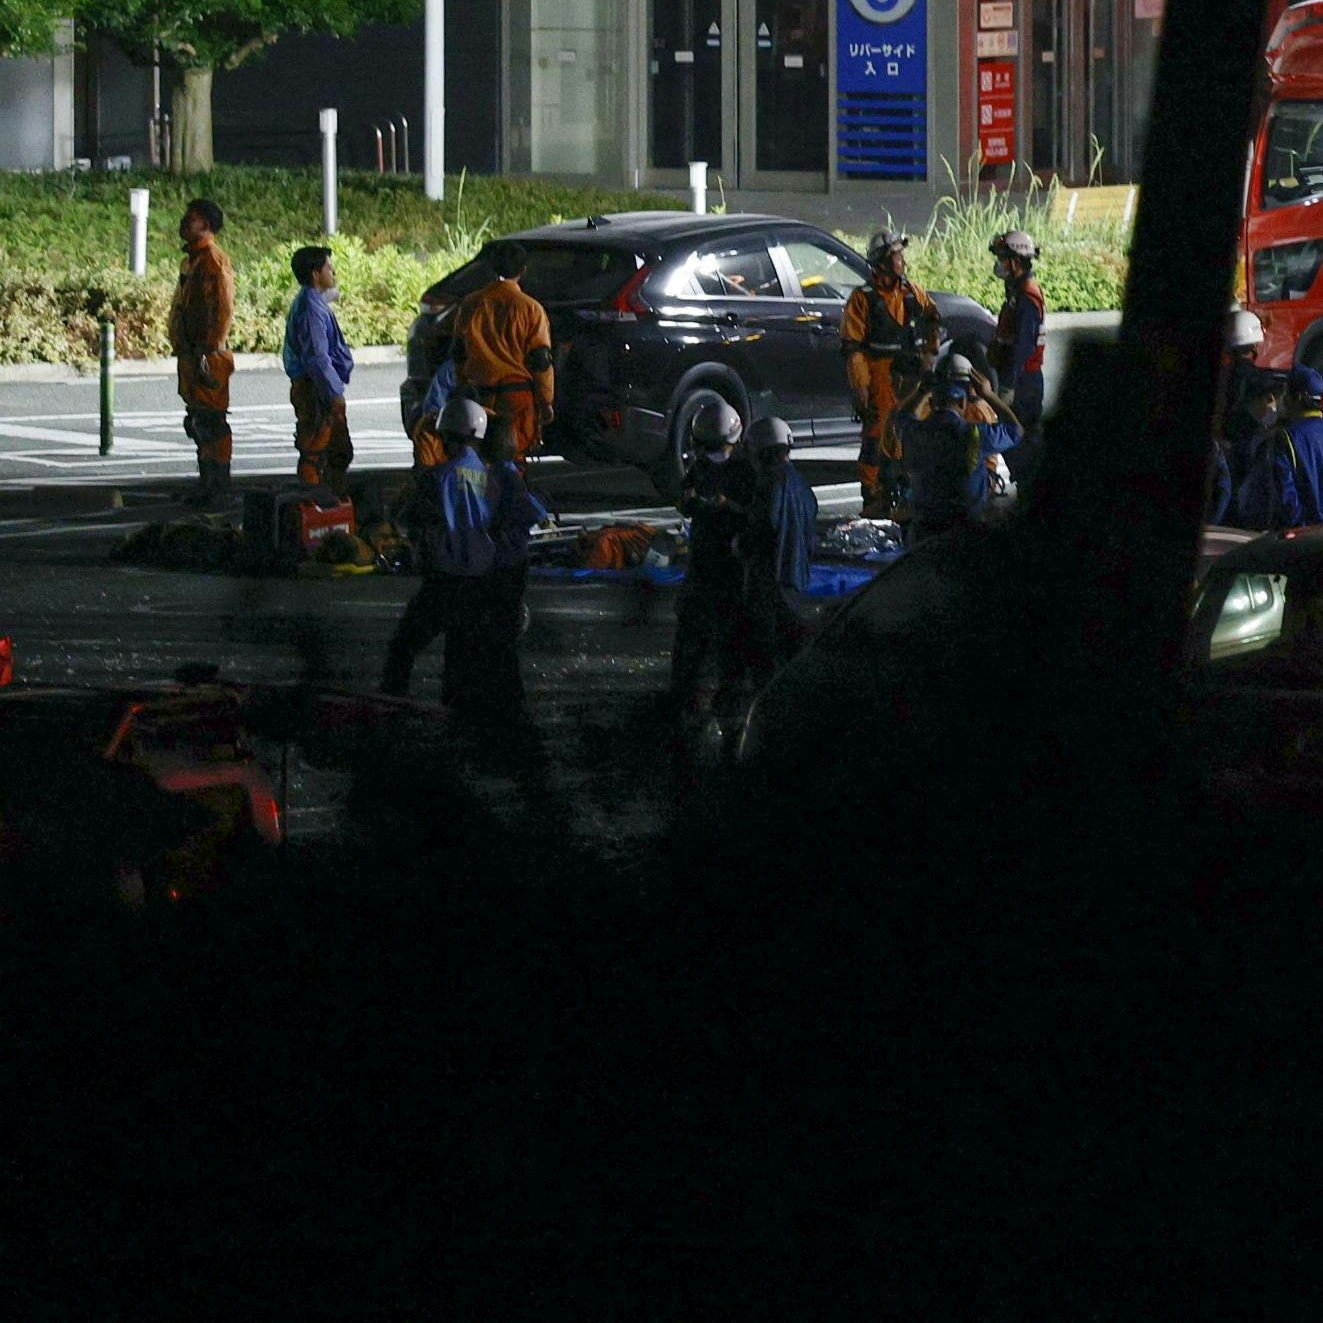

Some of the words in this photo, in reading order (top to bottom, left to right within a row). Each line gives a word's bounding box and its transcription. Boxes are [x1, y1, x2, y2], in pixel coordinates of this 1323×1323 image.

[849, 43, 916, 57] リバーサイド
[864, 61, 899, 76] 入口
